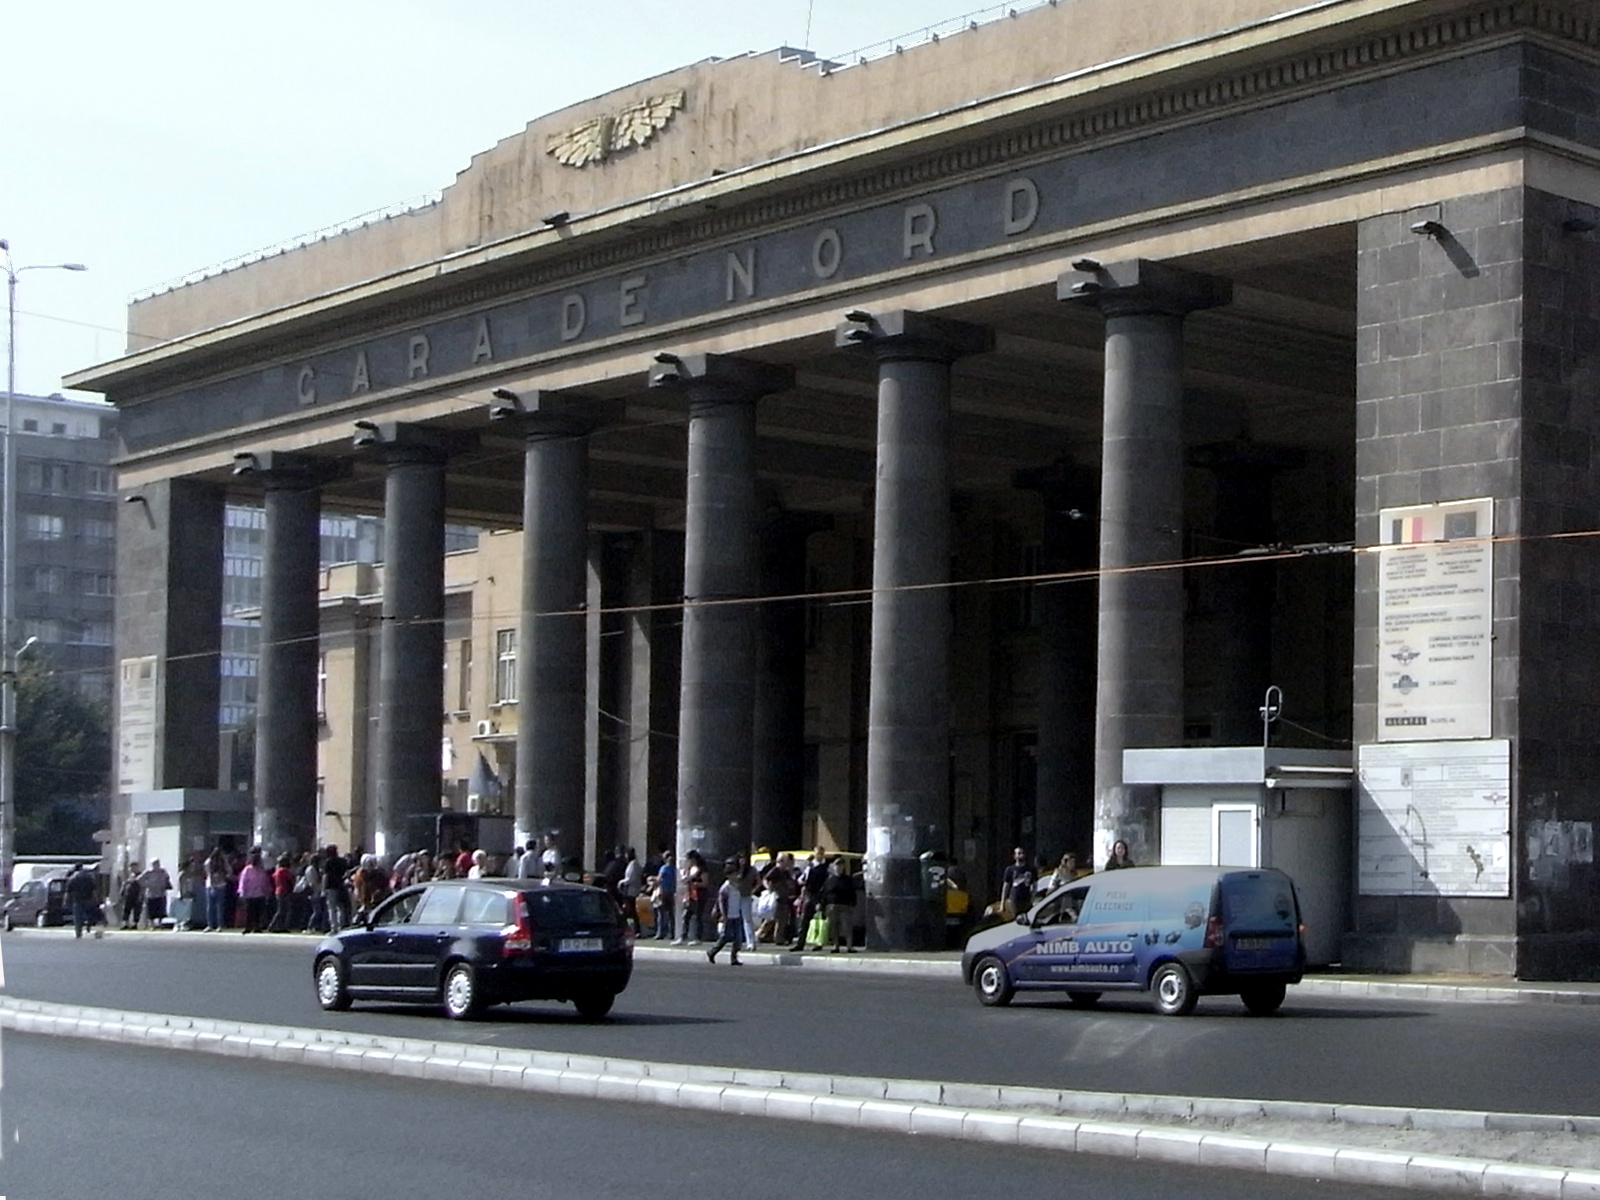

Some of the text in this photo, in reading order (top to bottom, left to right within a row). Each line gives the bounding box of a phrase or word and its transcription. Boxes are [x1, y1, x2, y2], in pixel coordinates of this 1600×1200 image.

[297, 177, 1039, 405] GARA DE NORD
[1095, 902, 1134, 911] ELECTRICE
[1036, 941, 1132, 954] NIMB AUTO
[1050, 963, 1120, 974] www.nimbauto.ro
